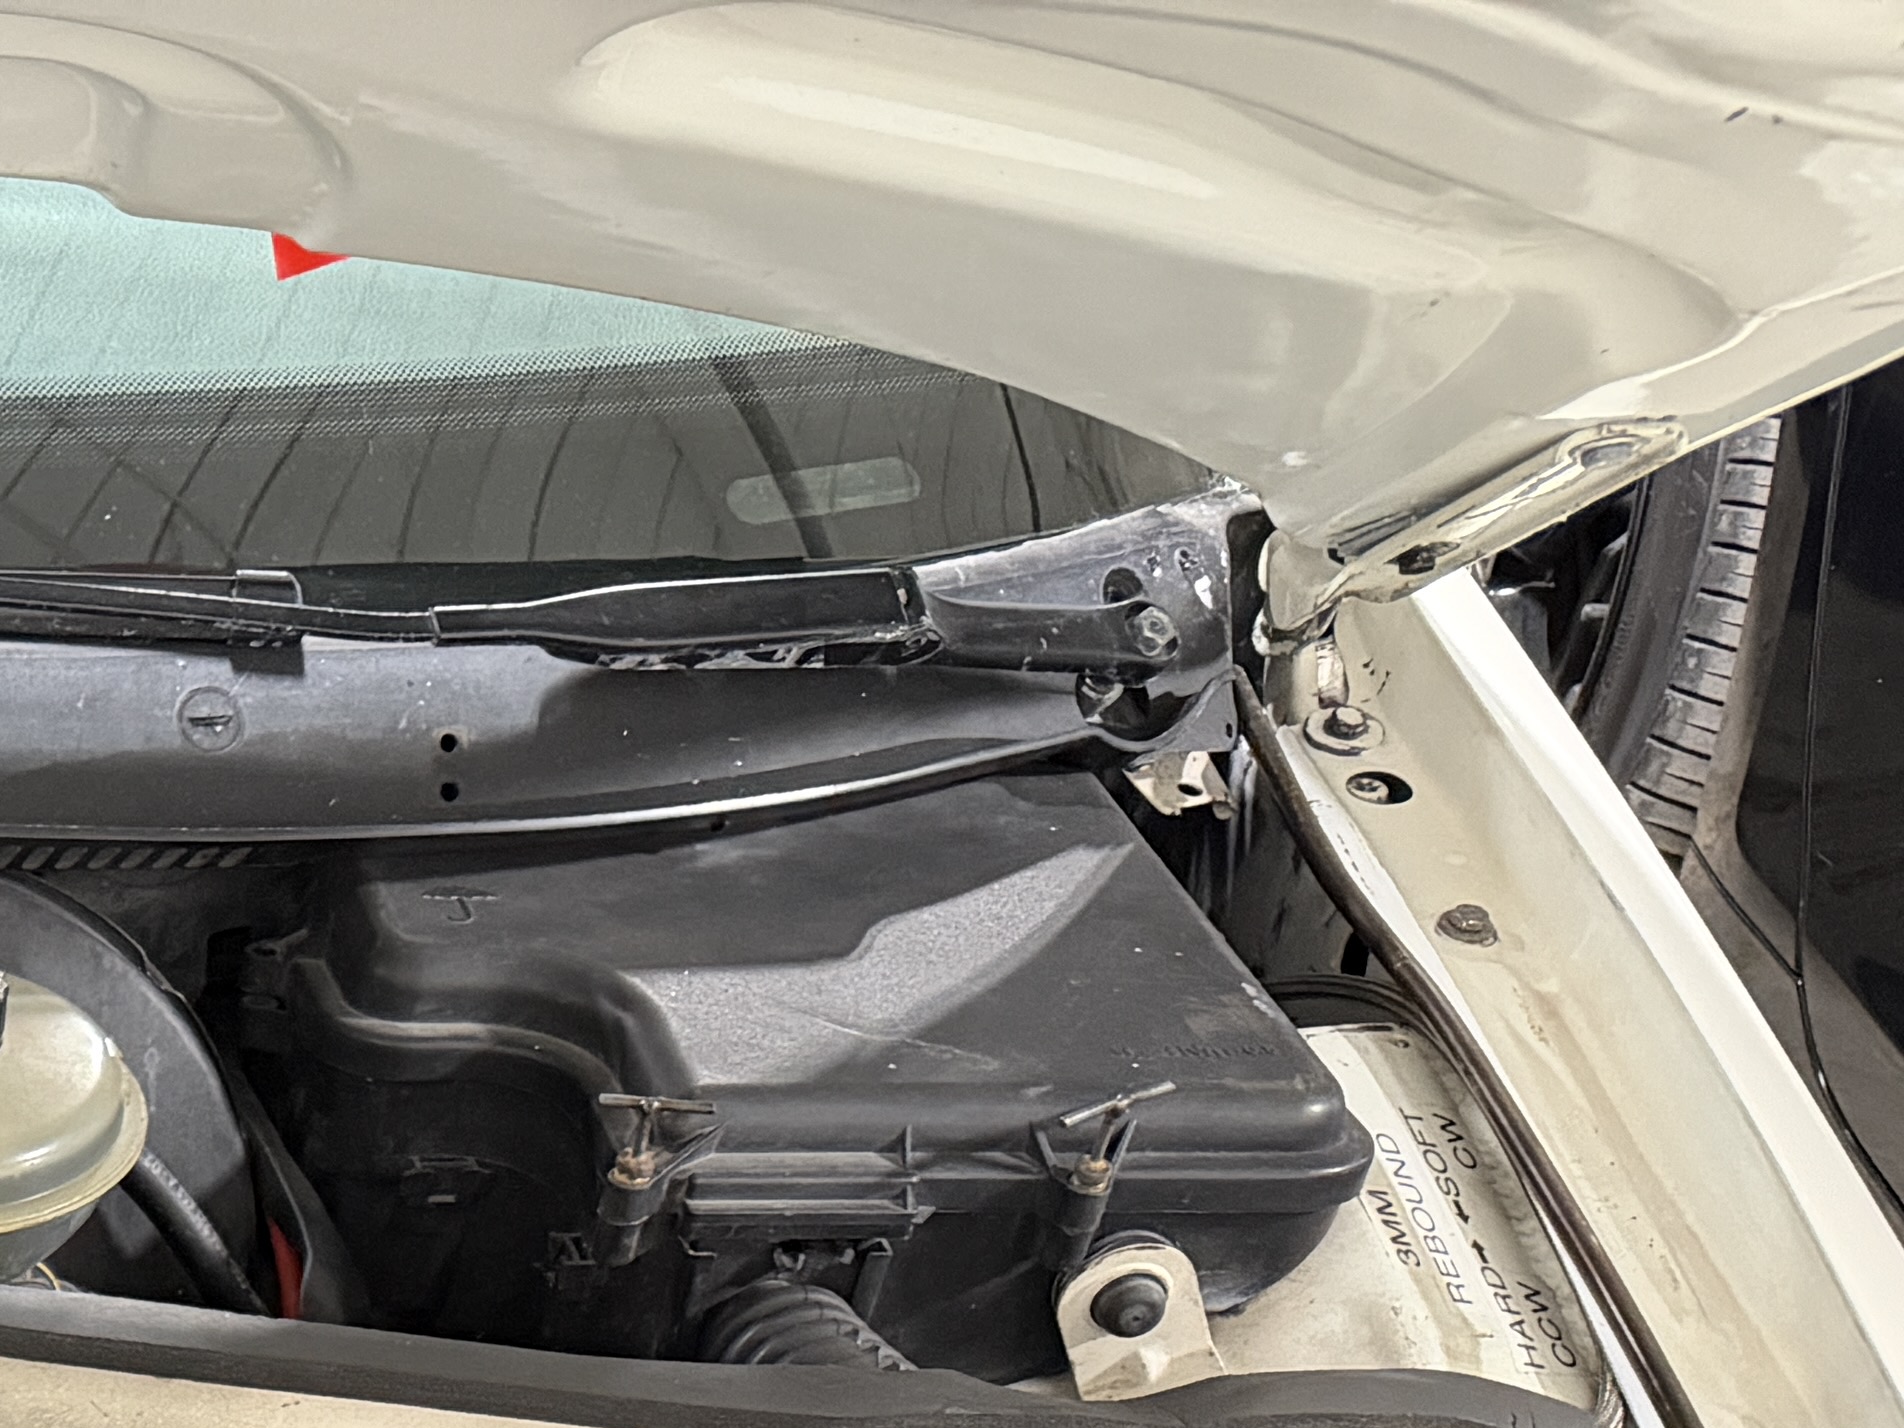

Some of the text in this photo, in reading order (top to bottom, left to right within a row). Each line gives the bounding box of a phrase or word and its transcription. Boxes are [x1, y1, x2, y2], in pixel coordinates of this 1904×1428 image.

[1368, 1189, 1421, 1267] 3MM
[1375, 1132, 1473, 1306] REBOUND
[1398, 1106, 1546, 1371] HARD SOFT
[1433, 1113, 1577, 1368] CCW CW
